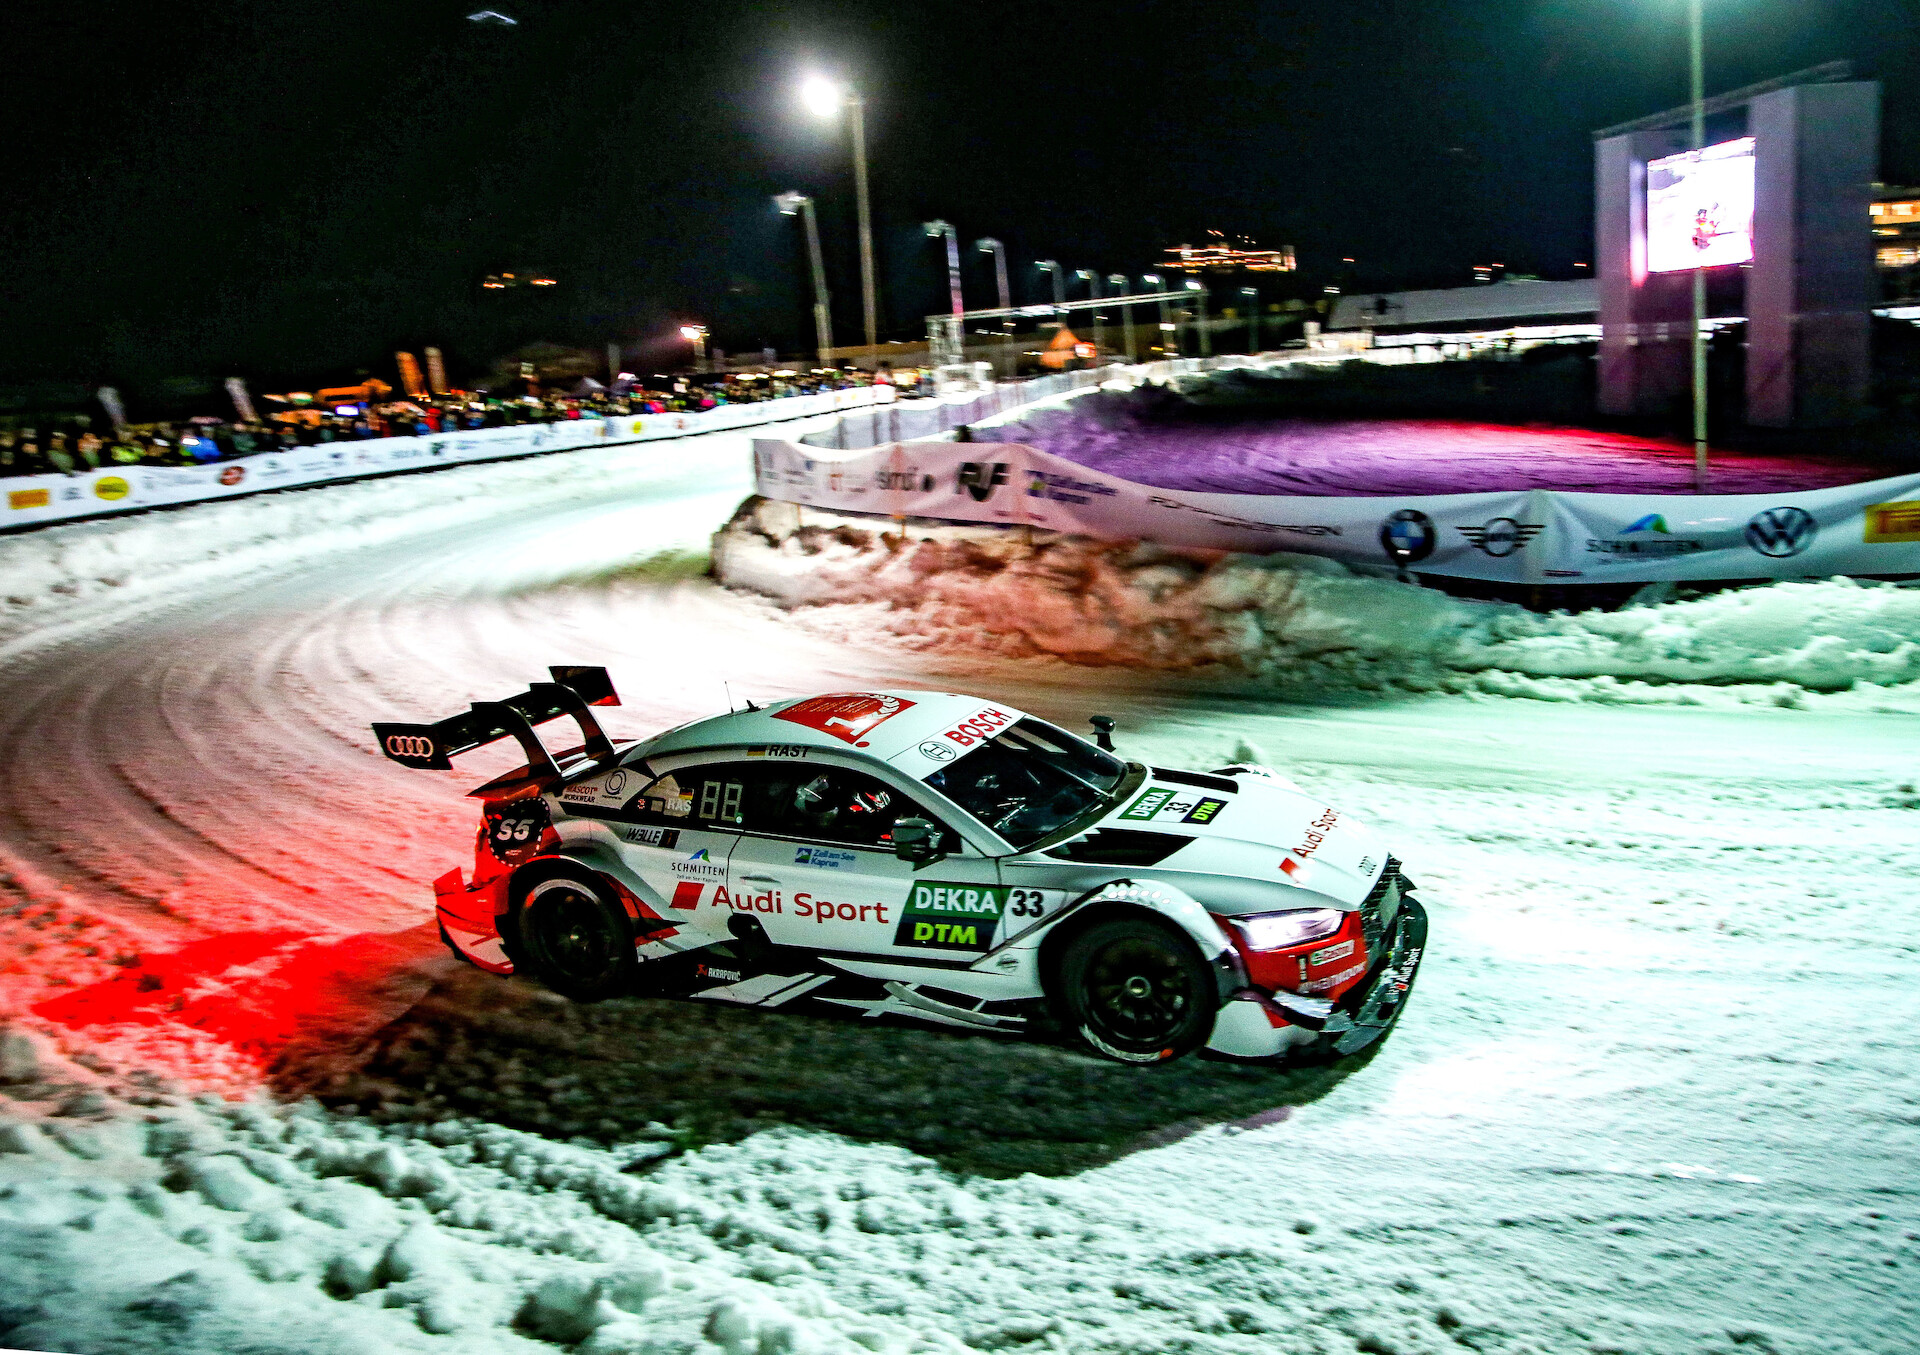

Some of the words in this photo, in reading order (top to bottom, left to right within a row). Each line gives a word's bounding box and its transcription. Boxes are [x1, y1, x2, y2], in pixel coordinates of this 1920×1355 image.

[944, 708, 1013, 747] BOSCH
[768, 744, 812, 758] RAST
[1128, 791, 1171, 817] DEKRA
[1163, 801, 1192, 813] 33
[1191, 801, 1220, 821] DTM
[496, 818, 535, 841] S5
[1292, 828, 1325, 858] Audi
[1311, 807, 1341, 831] Sport
[811, 857, 839, 868] Kaprun
[813, 849, 829, 858] Zell
[840, 852, 856, 861] See
[671, 862, 725, 876] SCHMITTEN
[712, 885, 782, 914] Audi
[794, 892, 889, 924] Sport
[914, 886, 998, 914] DEKRA
[1012, 890, 1044, 918] 33
[913, 922, 977, 945] DTM
